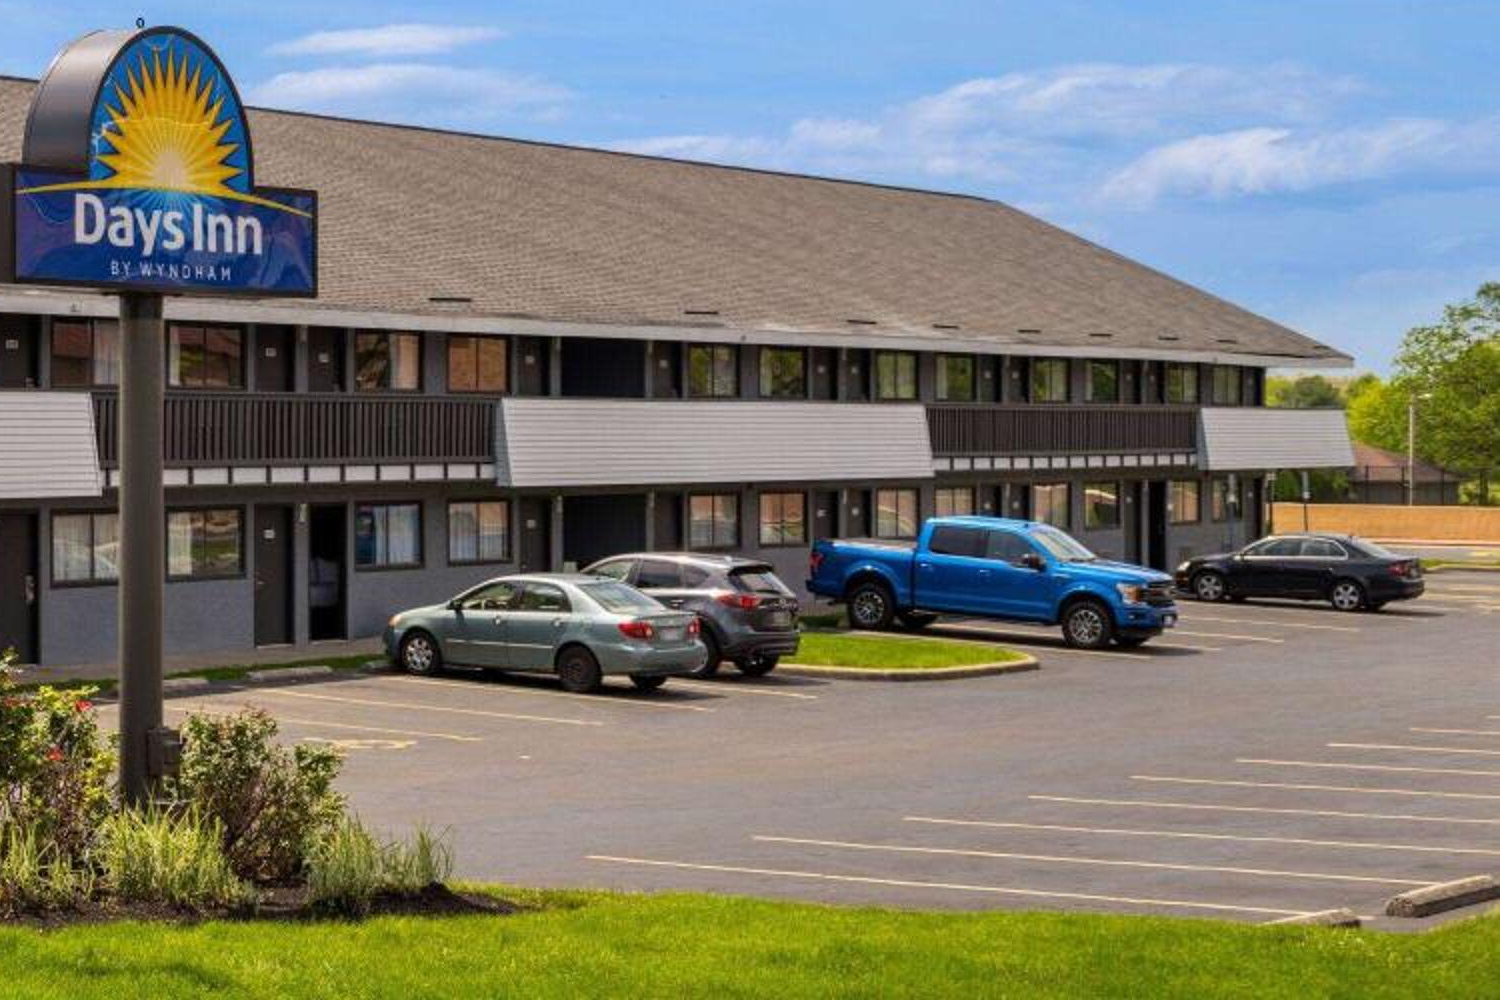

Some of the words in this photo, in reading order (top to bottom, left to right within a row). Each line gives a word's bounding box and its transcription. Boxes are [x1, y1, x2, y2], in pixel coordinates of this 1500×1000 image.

[75, 193, 184, 256] Days
[193, 203, 262, 255] Inn
[111, 260, 131, 276] BY
[141, 262, 231, 281] WYNDHAM
